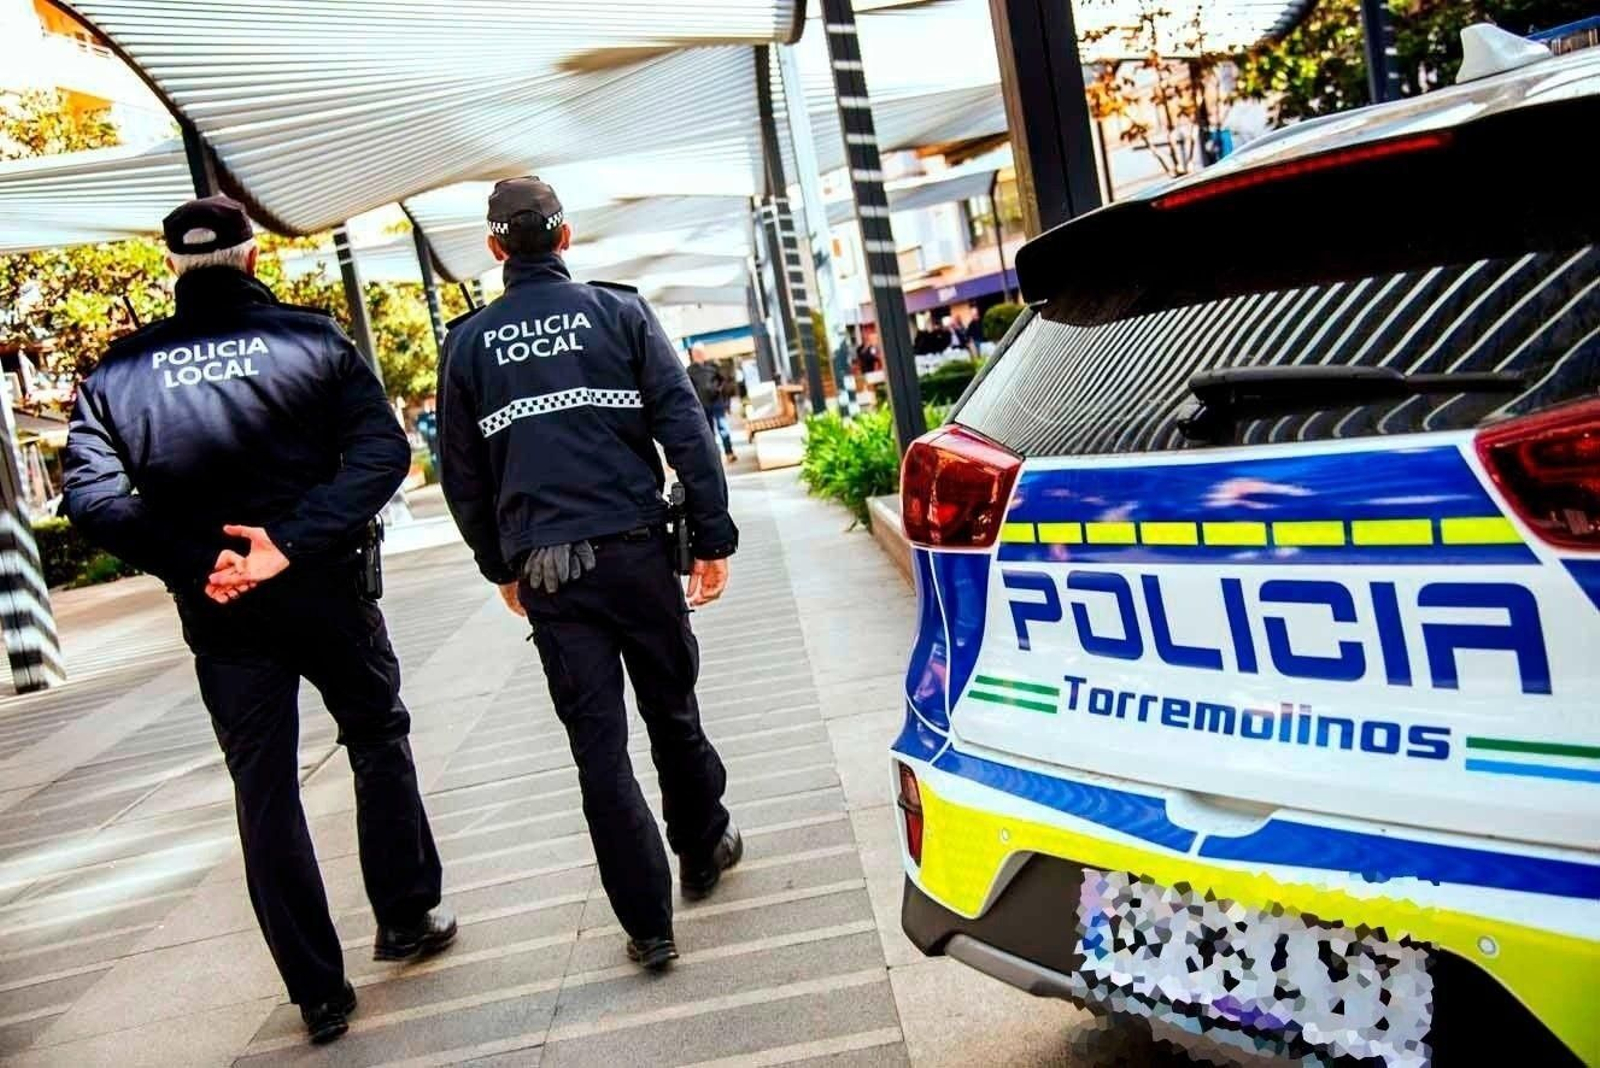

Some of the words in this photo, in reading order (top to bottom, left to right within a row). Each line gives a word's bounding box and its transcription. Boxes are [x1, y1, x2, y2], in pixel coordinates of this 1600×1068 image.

[483, 312, 592, 348] POLICIA
[152, 336, 269, 369] POLICIA
[495, 332, 584, 366] LOCAL
[164, 357, 259, 388] LOCAL
[1002, 569, 1553, 696] POLICIA
[1063, 675, 1452, 761] Torremolinos
